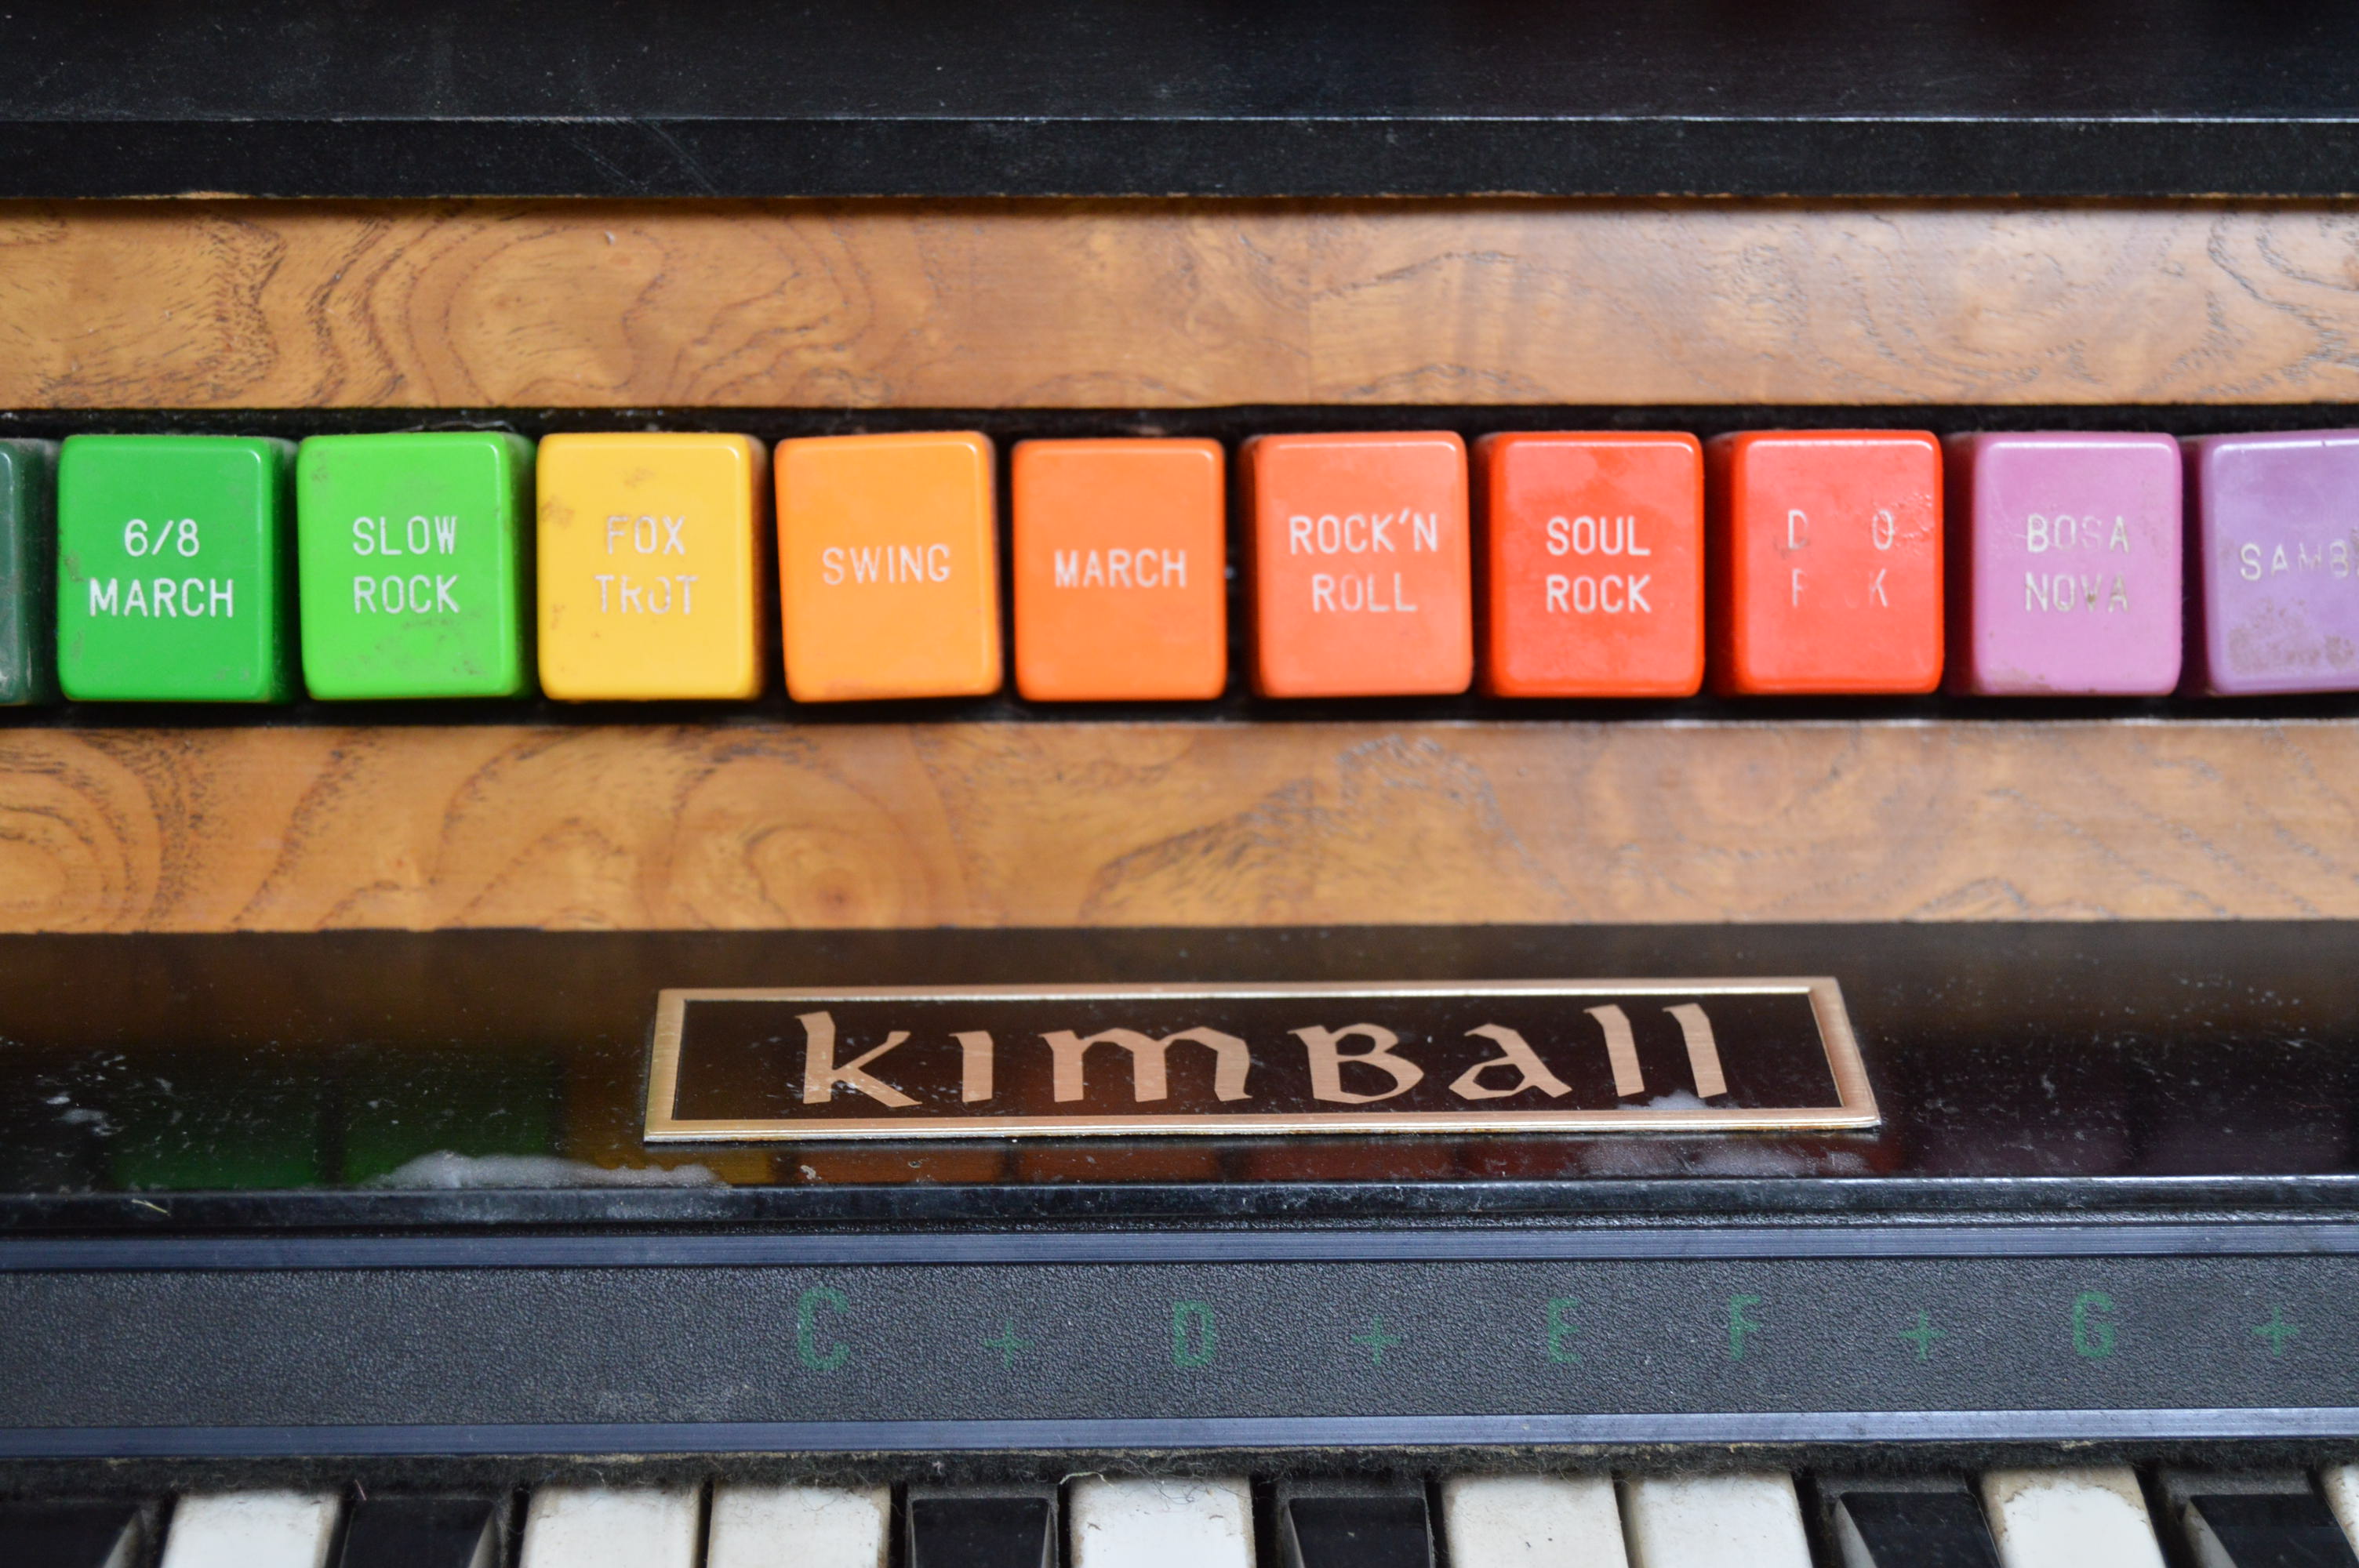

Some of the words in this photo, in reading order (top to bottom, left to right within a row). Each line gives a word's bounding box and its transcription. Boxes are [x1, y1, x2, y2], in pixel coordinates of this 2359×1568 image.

[124, 517, 201, 557] 6/8
[352, 514, 458, 556] SLOW
[606, 515, 686, 555] FOX
[1289, 508, 1438, 555] ROCK'N
[1547, 515, 1651, 556] SOUL
[2026, 514, 2129, 554] BOSA
[822, 543, 951, 586] SWING
[1055, 548, 1187, 588] MARCH
[2240, 539, 2359, 581] SAMB
[89, 577, 234, 618] MARCH
[353, 574, 460, 615] ROCK
[594, 574, 699, 615] TROT
[1312, 573, 1418, 612] ROLL
[1547, 574, 1652, 613] ROCK
[2025, 572, 2129, 612] NOVA
[797, 1287, 850, 1370] C
[1176, 1301, 1216, 1367] D
[1548, 1298, 1579, 1363] E
[1730, 1294, 1761, 1360] F
[2072, 1291, 2116, 1358] G
